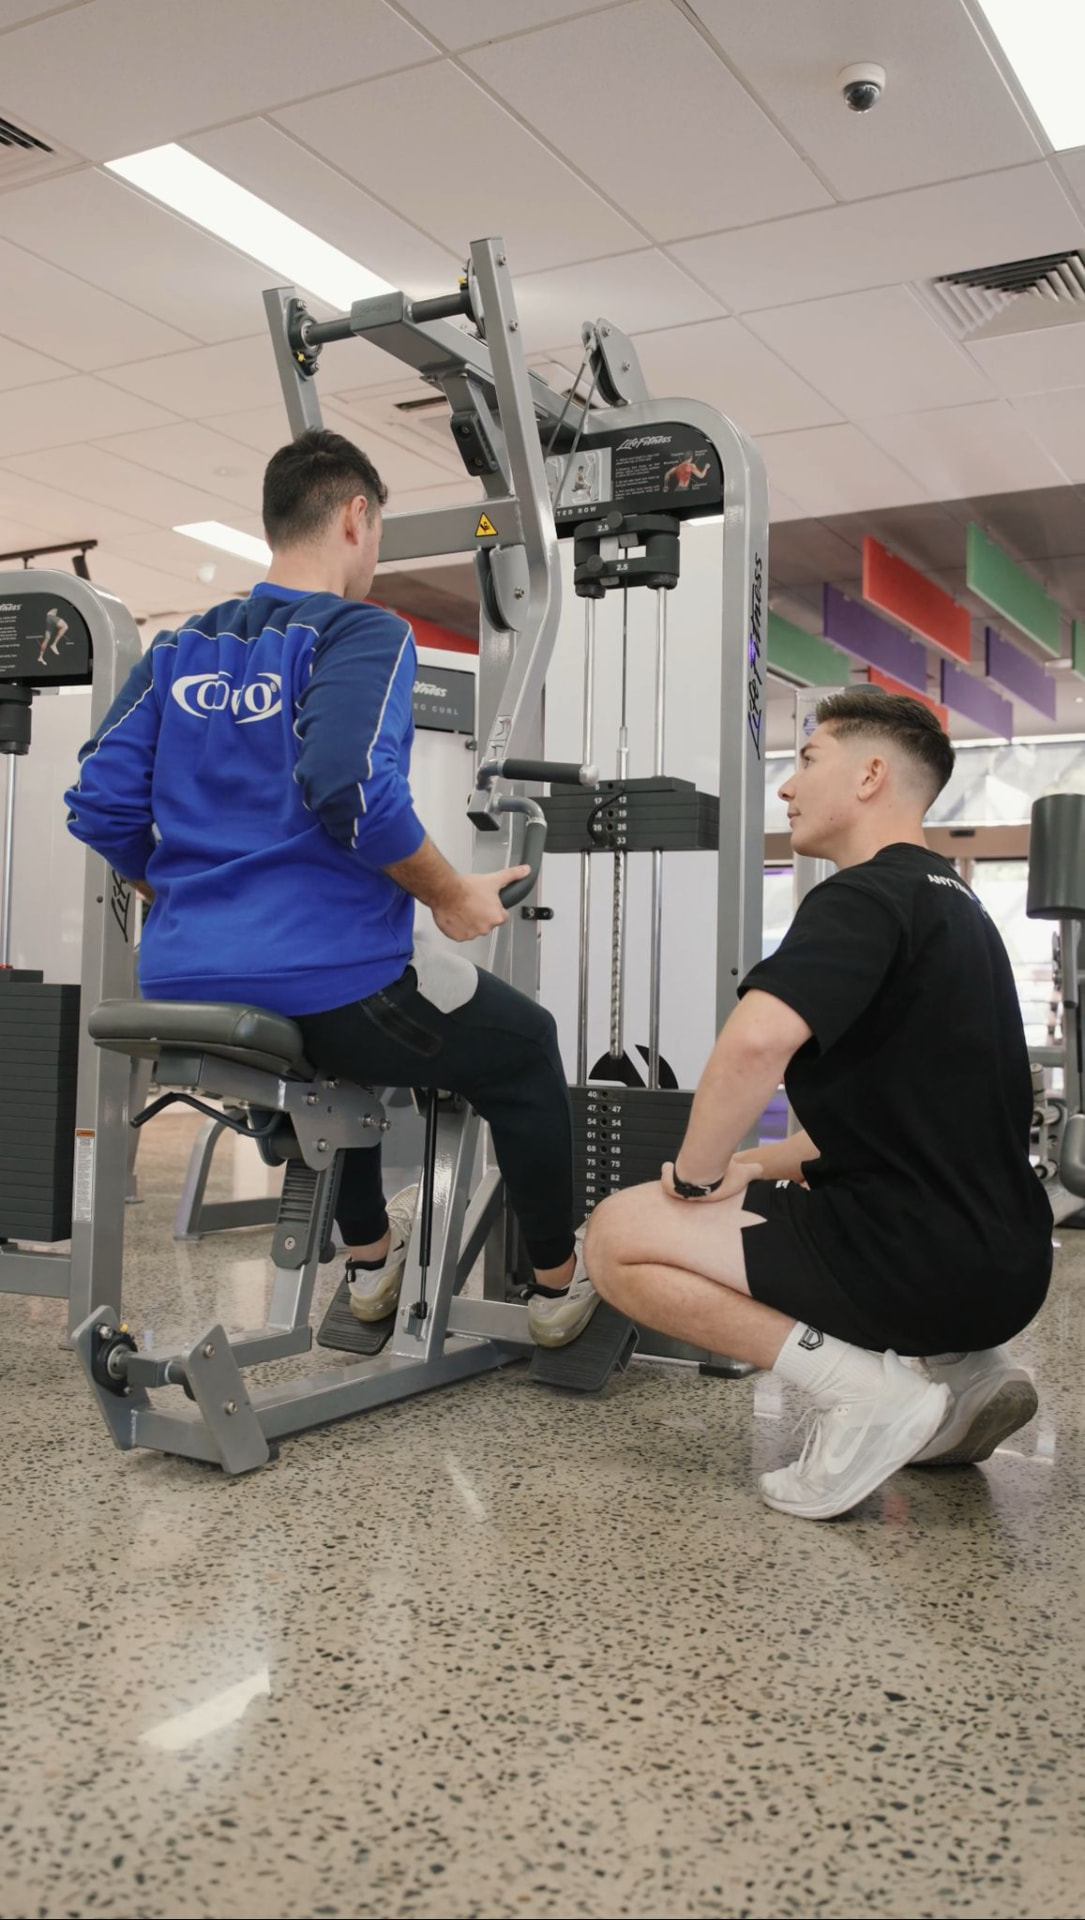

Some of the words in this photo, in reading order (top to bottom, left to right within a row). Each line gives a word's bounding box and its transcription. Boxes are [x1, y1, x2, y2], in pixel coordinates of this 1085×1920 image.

[578, 505, 597, 515] ROW
[616, 563, 629, 571] 2.5
[617, 823, 627, 831] 26
[587, 1090, 598, 1098] 40
[587, 1104, 597, 1112] 47
[611, 1105, 621, 1113] 47
[587, 1117, 597, 1125] 54
[611, 1119, 621, 1127] 54
[586, 1131, 596, 1139] 61
[611, 1132, 620, 1140] 61
[586, 1144, 597, 1153] 68
[610, 1146, 621, 1154] 68
[586, 1158, 597, 1166] 75
[610, 1160, 620, 1168] 75
[586, 1172, 596, 1180] 82
[610, 1173, 620, 1181] 82
[586, 1185, 596, 1193] 89
[585, 1199, 595, 1207] 96
